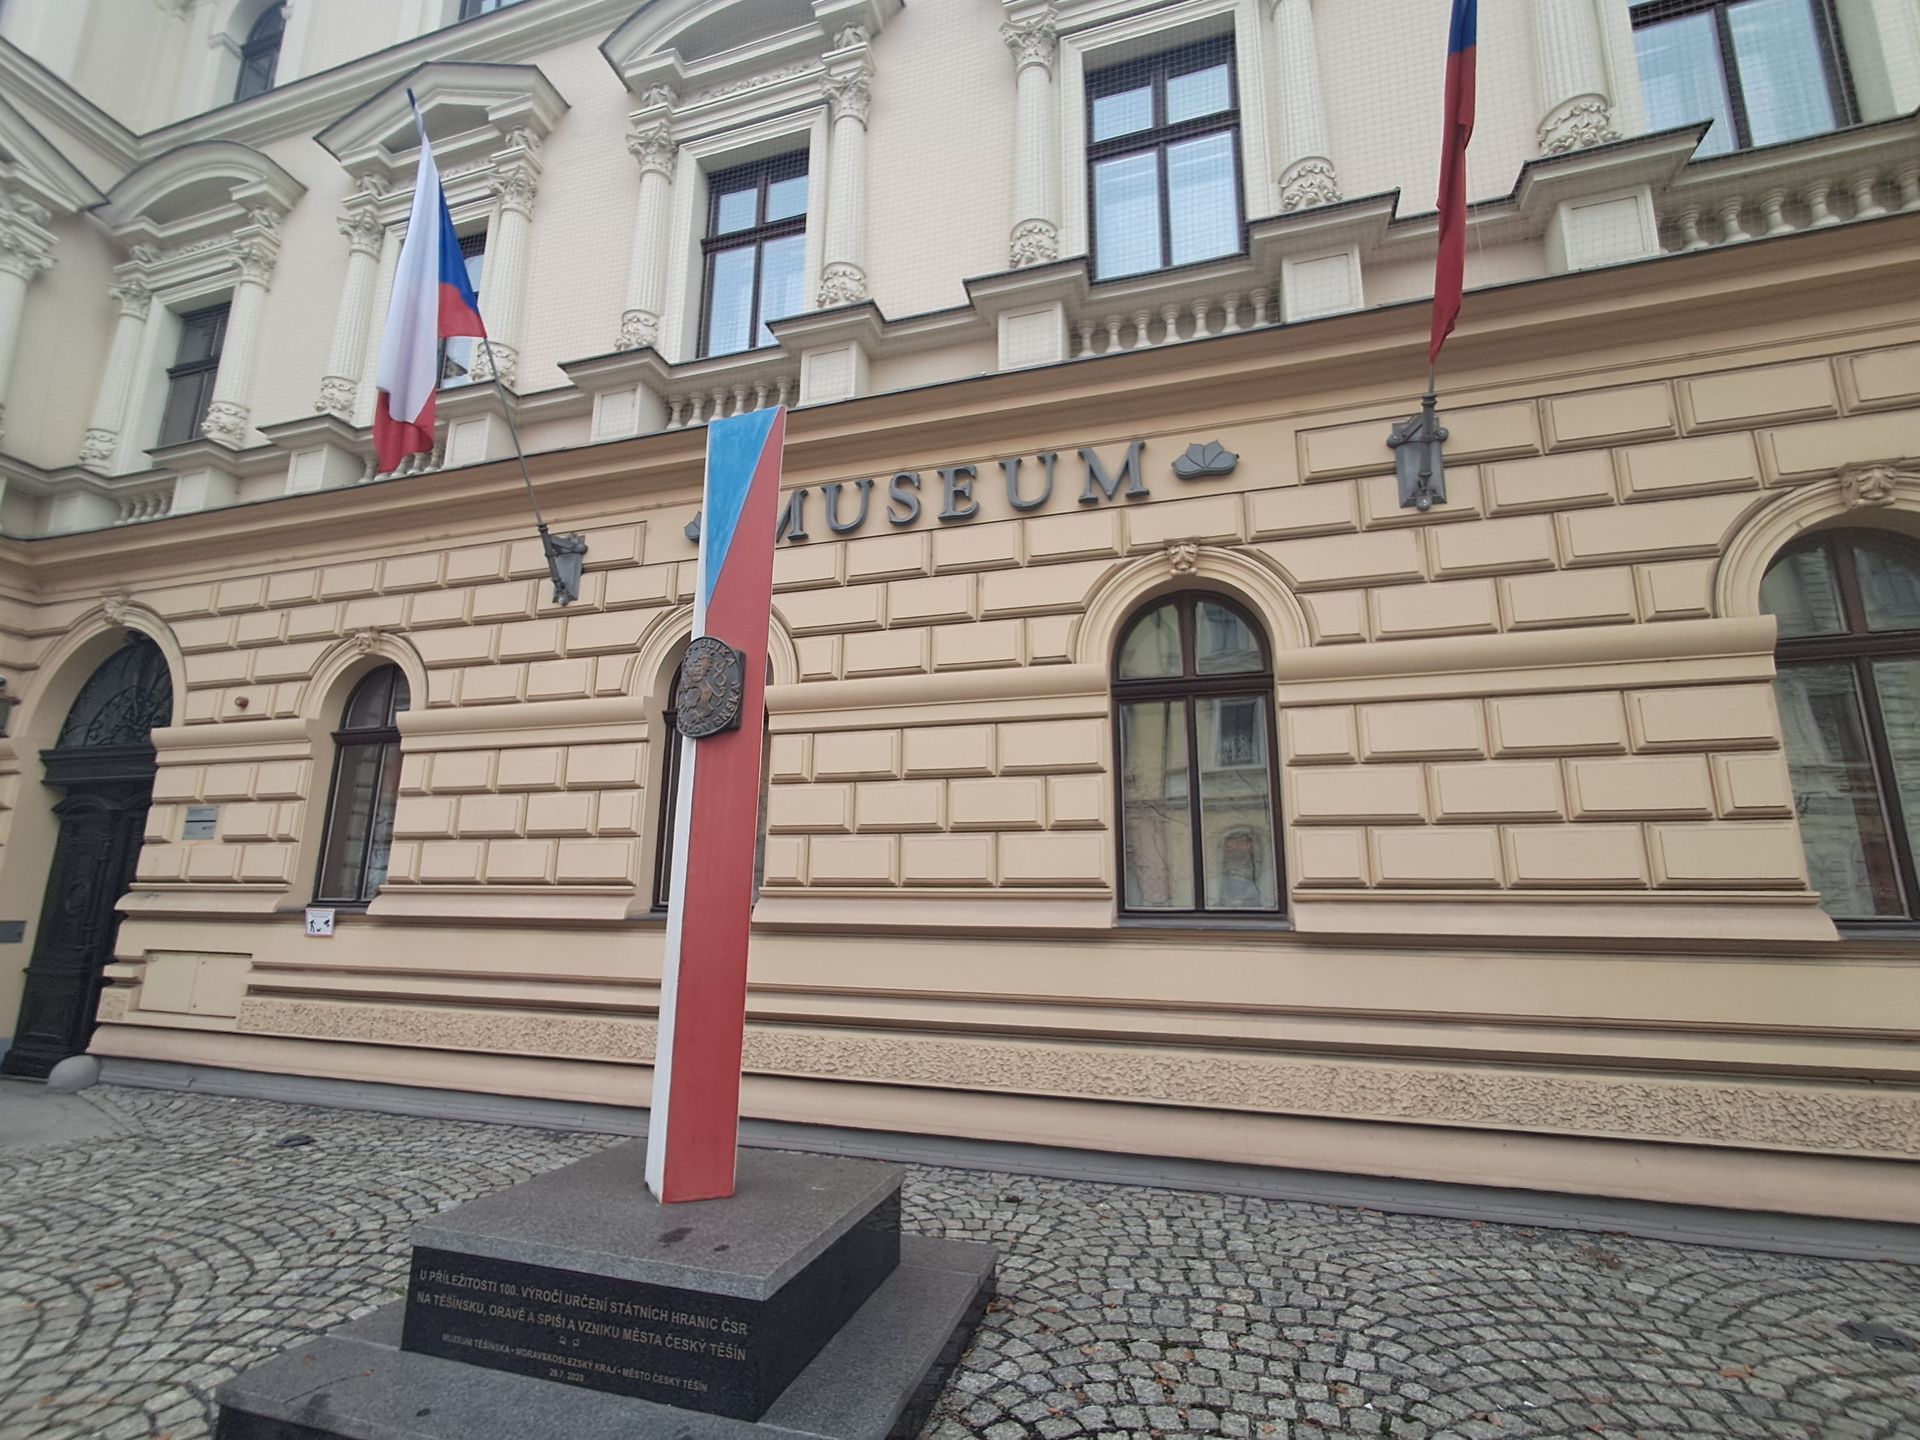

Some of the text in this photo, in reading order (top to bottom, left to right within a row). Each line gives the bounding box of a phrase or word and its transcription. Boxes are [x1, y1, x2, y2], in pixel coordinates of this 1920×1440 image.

[416, 1291, 747, 1361] NA TĚŠÍNSKU, ORAVĚ A SPIŠI A VZNIKU MĚSTA ČESKÝ TĚŠÍN
[419, 1269, 748, 1335] U PŘÍLEŽITOSTI 100. VÝROČÍ URČENÍ STÁTNÍCH HRANIC ČSR
[515, 1347, 594, 1370] MORAVSKOSLEZSKÝ
[593, 1361, 617, 1375] KRAJ
[622, 1367, 652, 1381] MĚSTO
